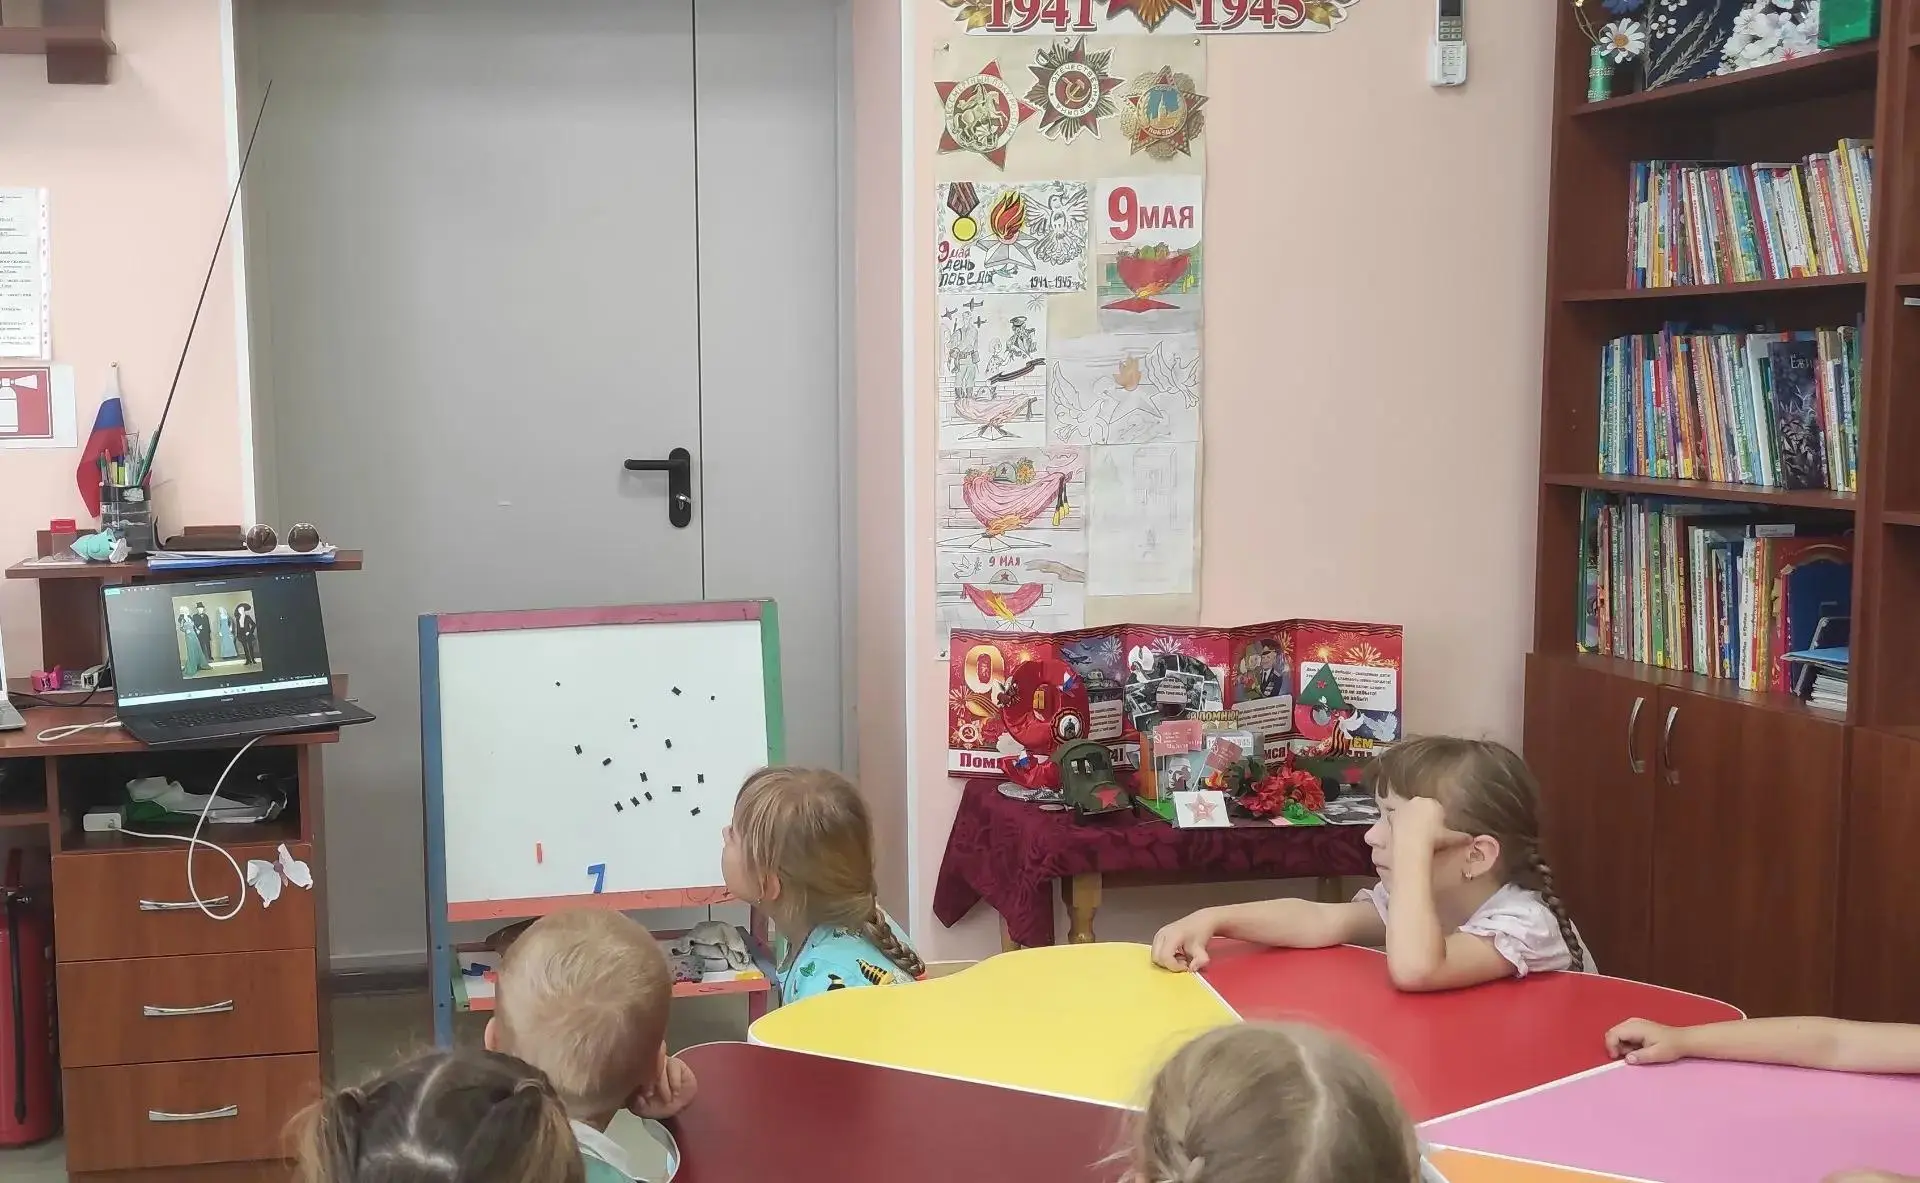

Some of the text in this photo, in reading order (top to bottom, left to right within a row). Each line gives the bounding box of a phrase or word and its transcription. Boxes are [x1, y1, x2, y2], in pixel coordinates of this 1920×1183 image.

[986, 0, 1097, 32] 1941
[1196, 0, 1306, 30] 1945
[1051, 64, 1099, 109] ОТЕЧЕСТВЕННАЯ
[1148, 126, 1176, 136] ПОБЕДА
[1108, 186, 1194, 241] 9 МАЯ
[938, 240, 950, 263] 9
[988, 555, 1021, 567] 9 МАЯ
[964, 644, 1005, 719] 9
[587, 863, 606, 895] 7
